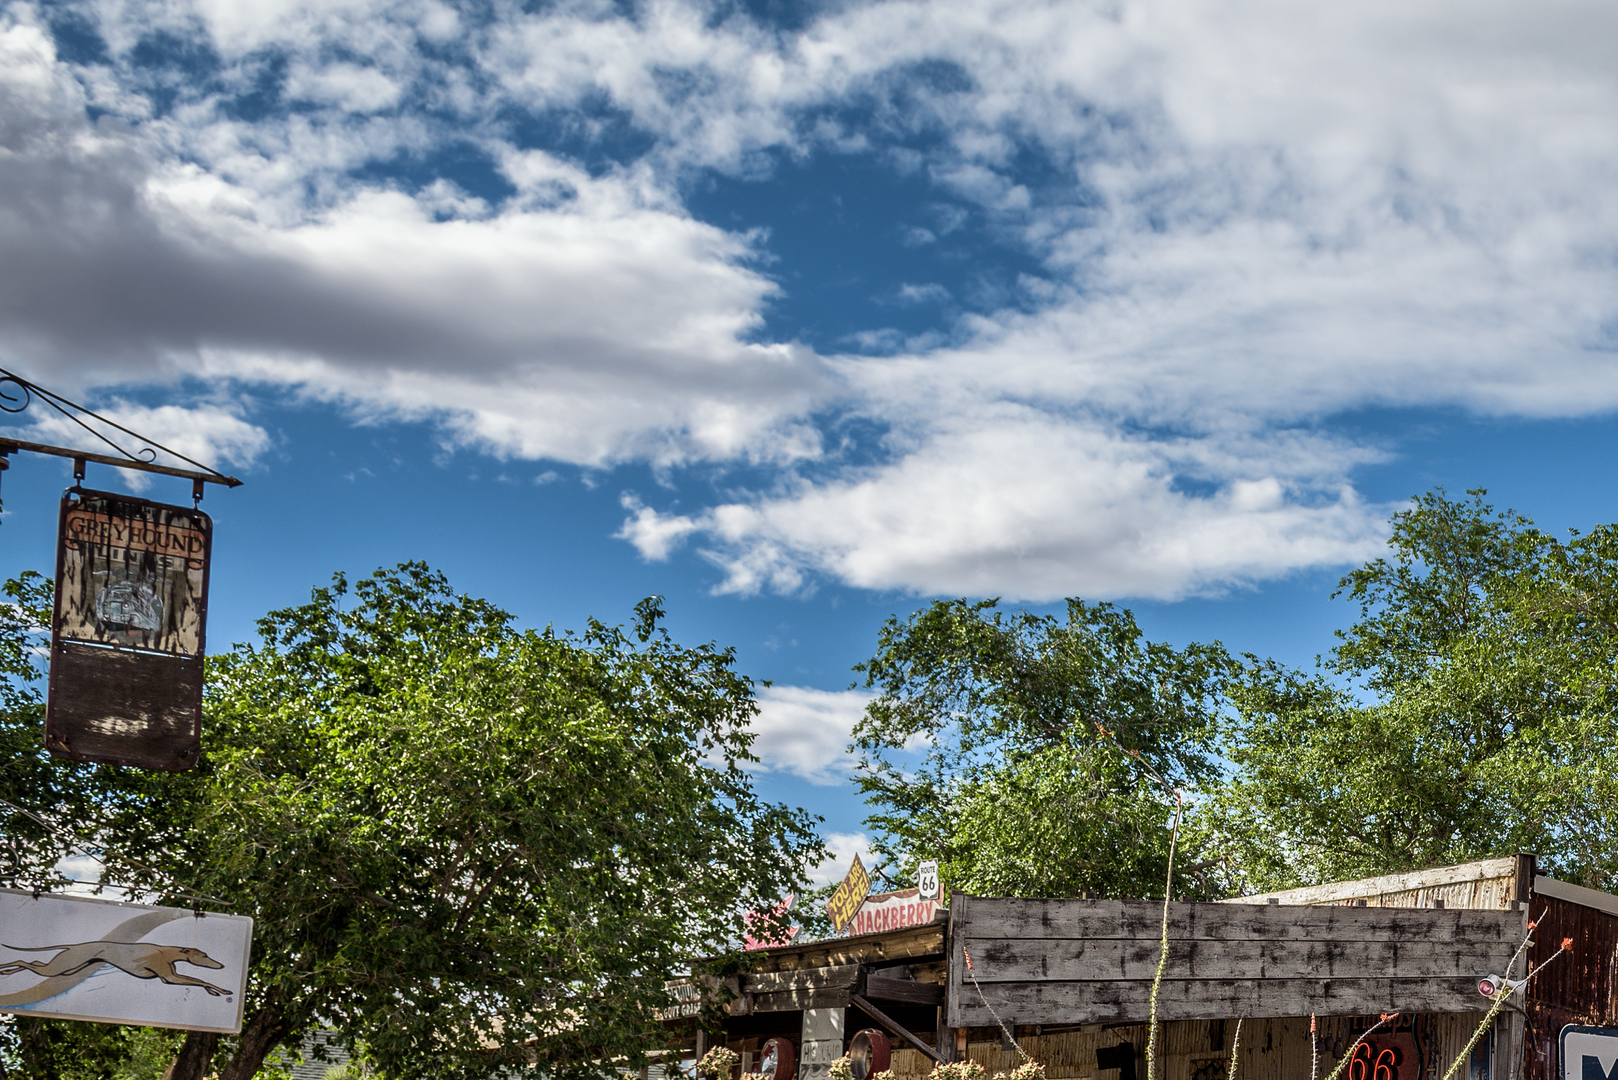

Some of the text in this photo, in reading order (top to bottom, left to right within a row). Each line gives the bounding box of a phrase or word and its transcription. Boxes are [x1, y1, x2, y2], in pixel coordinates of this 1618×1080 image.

[69, 516, 203, 553] GREYHOUND
[99, 544, 174, 568] LINS
[829, 860, 862, 912] YOU ARE
[920, 866, 936, 875] ROUTE
[922, 876, 935, 891] 66
[835, 871, 868, 930] HERE!
[856, 900, 933, 935] HACKBERRY
